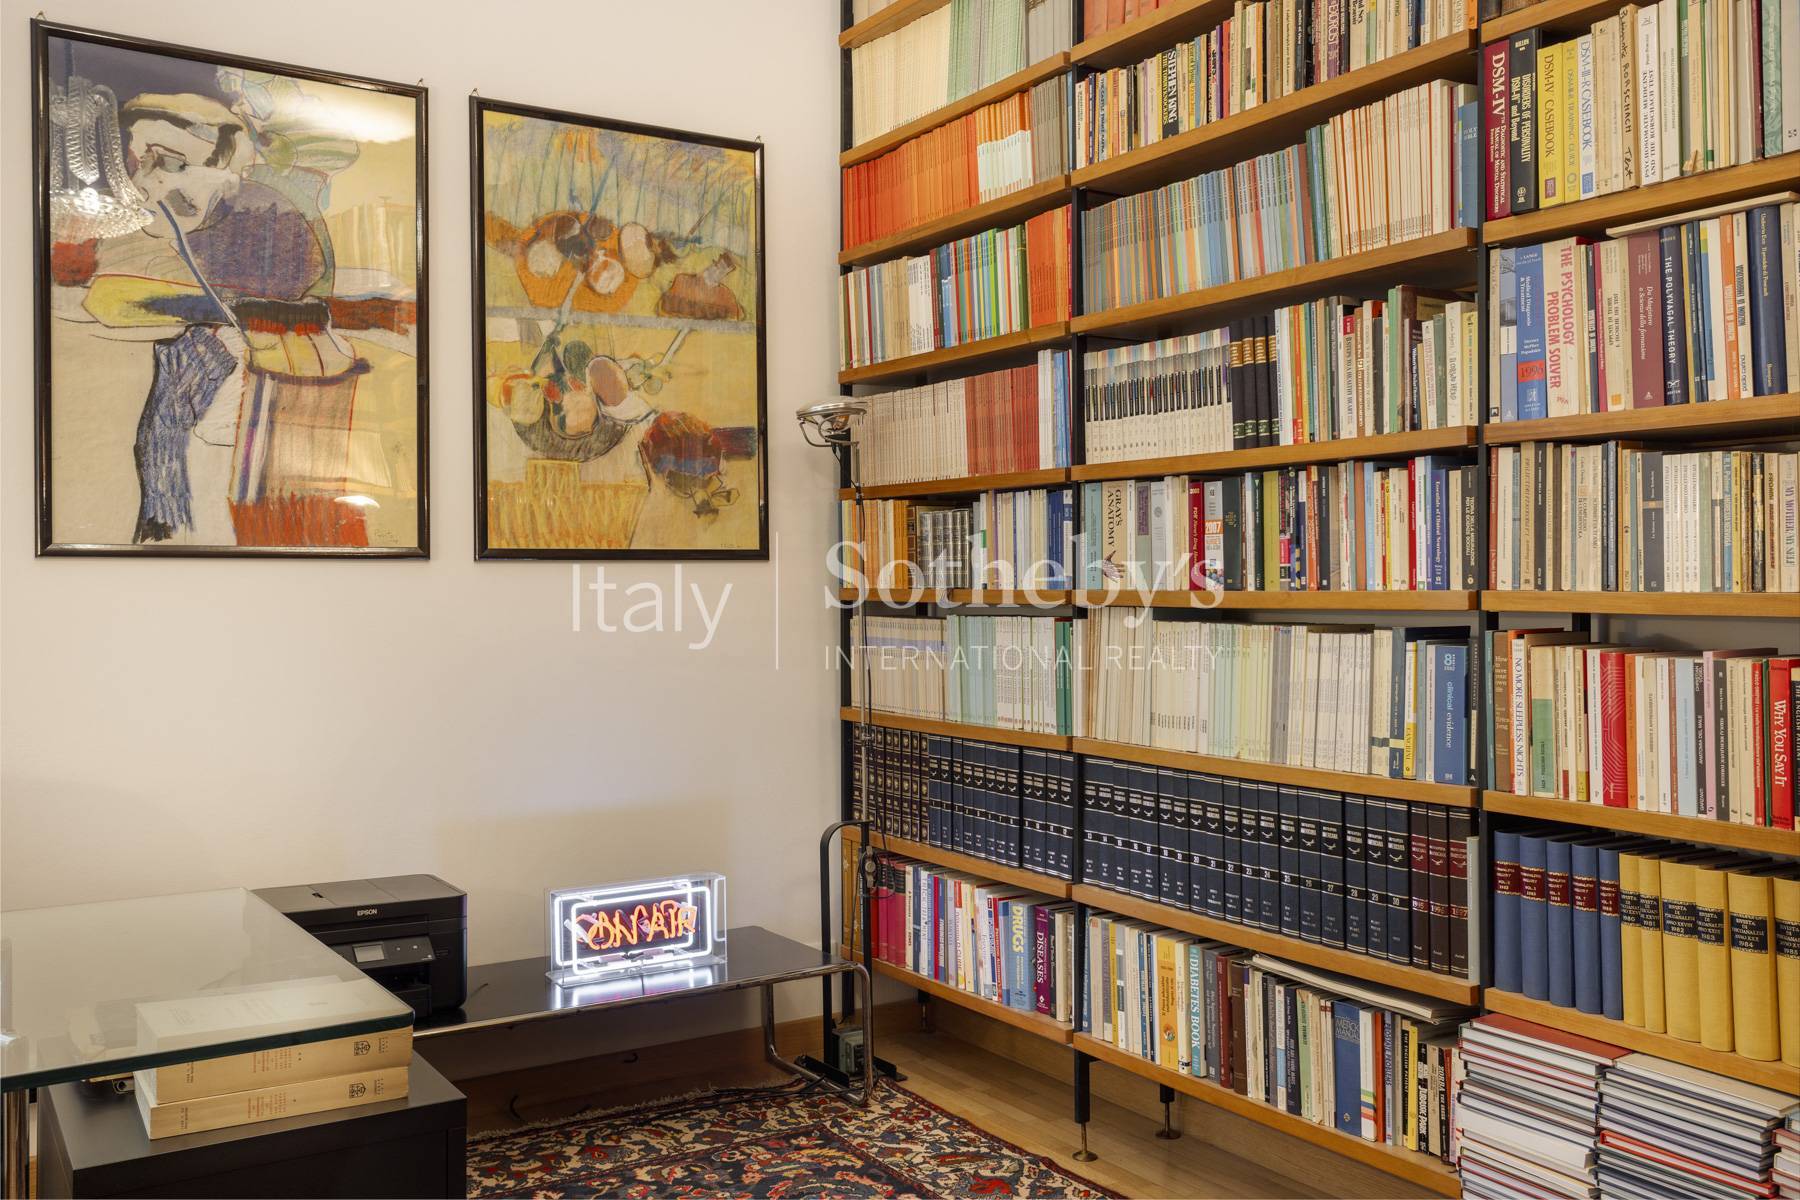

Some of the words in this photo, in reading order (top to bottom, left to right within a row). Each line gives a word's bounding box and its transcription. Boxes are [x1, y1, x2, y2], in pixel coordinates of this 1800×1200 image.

[1329, 5, 1338, 45] EXORCIST
[1168, 50, 1178, 98] STEPHEN
[1544, 54, 1554, 94] DSM-IV
[1520, 74, 1531, 110] DISORDERS
[1168, 98, 1178, 123] KING
[1510, 105, 1520, 117] and
[1520, 111, 1531, 120] OF
[1582, 89, 1592, 152] CASEBOOK
[1510, 118, 1520, 142] Beyond
[1520, 121, 1531, 162] PERSONALITY
[1544, 100, 1554, 158] CASEBOOK
[1561, 246, 1572, 268] THE
[1664, 256, 1672, 274] THE
[1646, 286, 1654, 296] Da
[1665, 277, 1674, 327] POLYVAGAL
[1547, 291, 1560, 346] PROBLEM
[1561, 272, 1574, 346] PSYCHOLOGY
[1646, 296, 1654, 326] Magistero
[1667, 330, 1676, 364] THEORY
[1549, 349, 1561, 389] SOLVER
[1206, 521, 1221, 534] 2007
[1516, 658, 1522, 672] NO
[1446, 681, 1454, 710] clinical
[1774, 700, 1787, 728] WHY
[1446, 712, 1454, 748] evidence
[1774, 728, 1787, 752] YOU
[1774, 753, 1787, 775] SAY
[1774, 775, 1787, 787] IT
[357, 908, 378, 916] EPSON
[1012, 905, 1024, 953] DRUGS
[1189, 958, 1200, 1013] DIABETES
[1191, 1016, 1200, 1048] BOOK
[1336, 1028, 1360, 1040] MANUAL
[1419, 1084, 1428, 1114] JURASSIC
[1419, 1115, 1428, 1135] PARK
